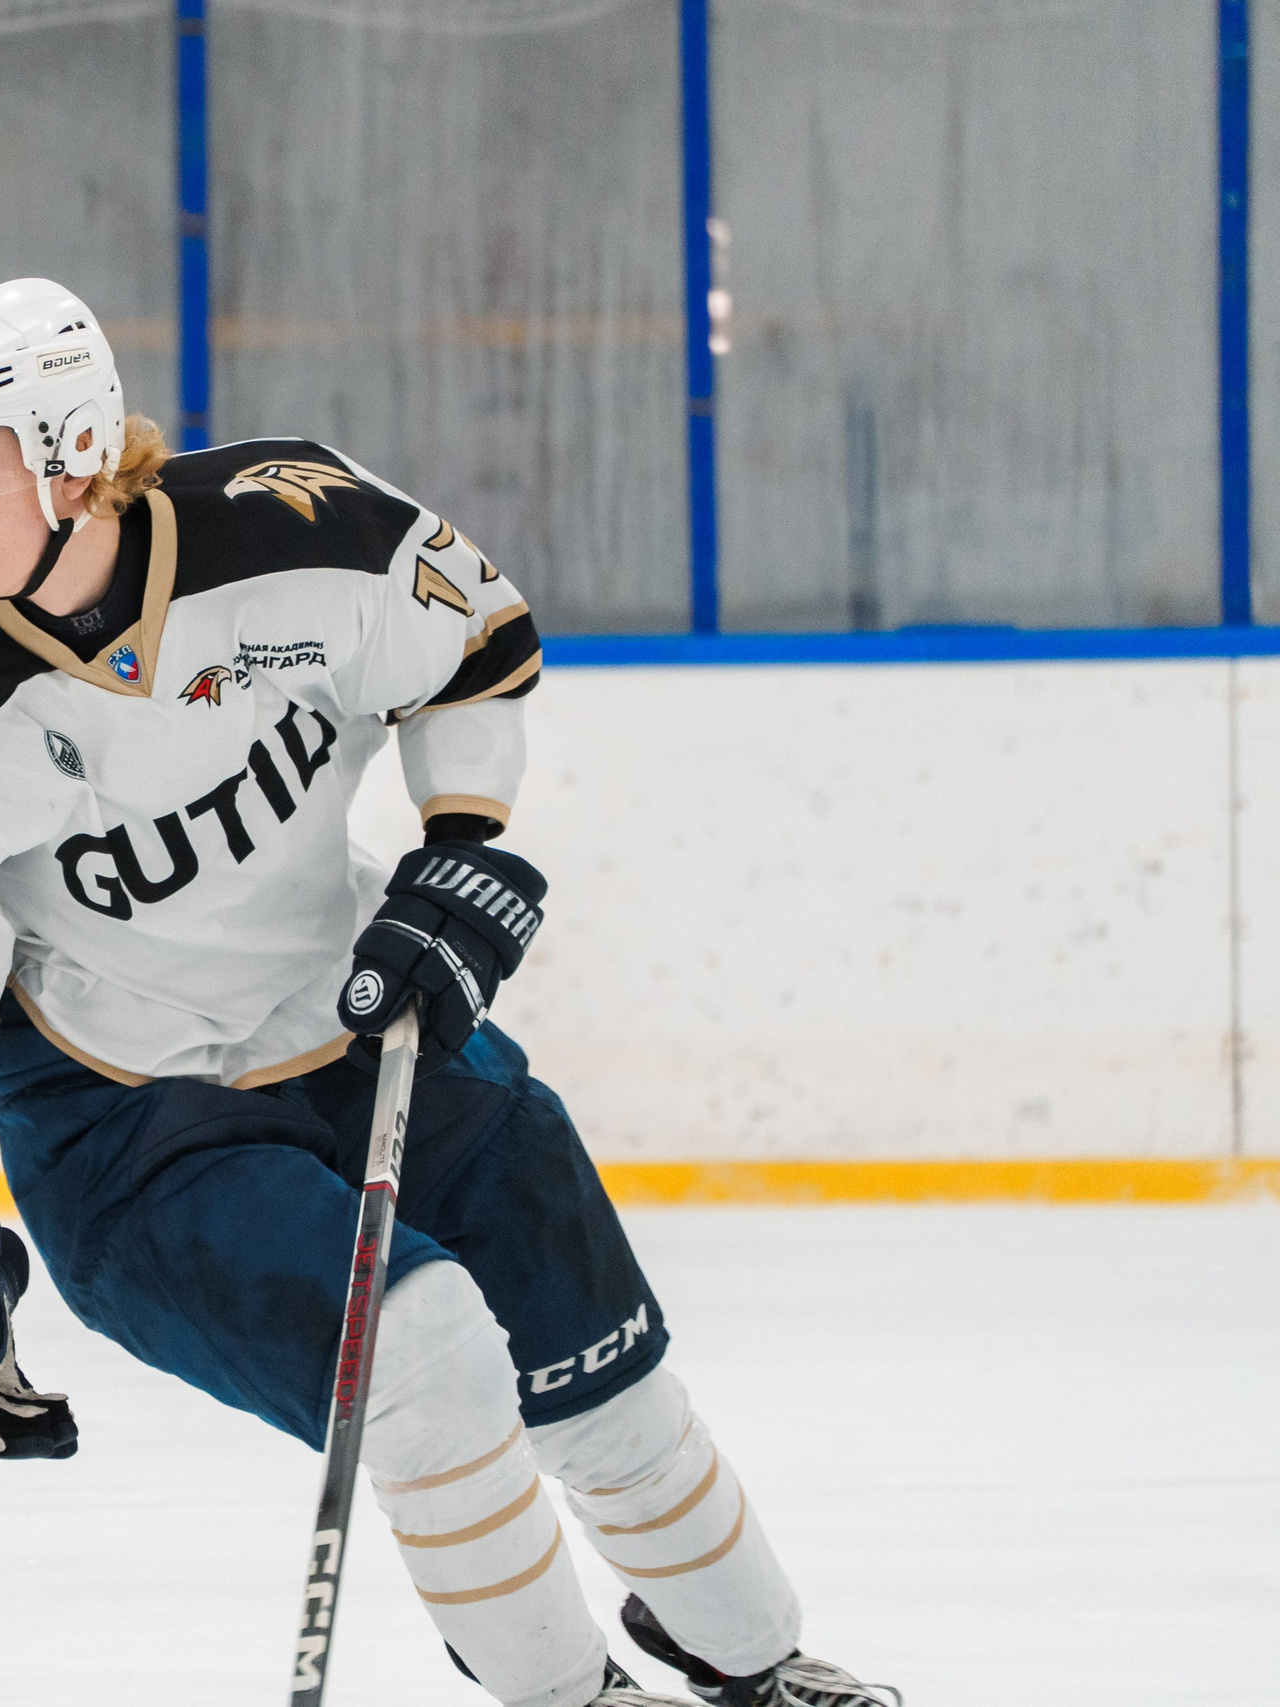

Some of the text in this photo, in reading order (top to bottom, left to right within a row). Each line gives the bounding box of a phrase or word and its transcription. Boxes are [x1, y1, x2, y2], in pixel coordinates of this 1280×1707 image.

[42, 352, 91, 370] BAUER
[335, 1233, 377, 1407] JETSPEED
[526, 1303, 650, 1394] CCM
[291, 1528, 342, 1693] CCM
